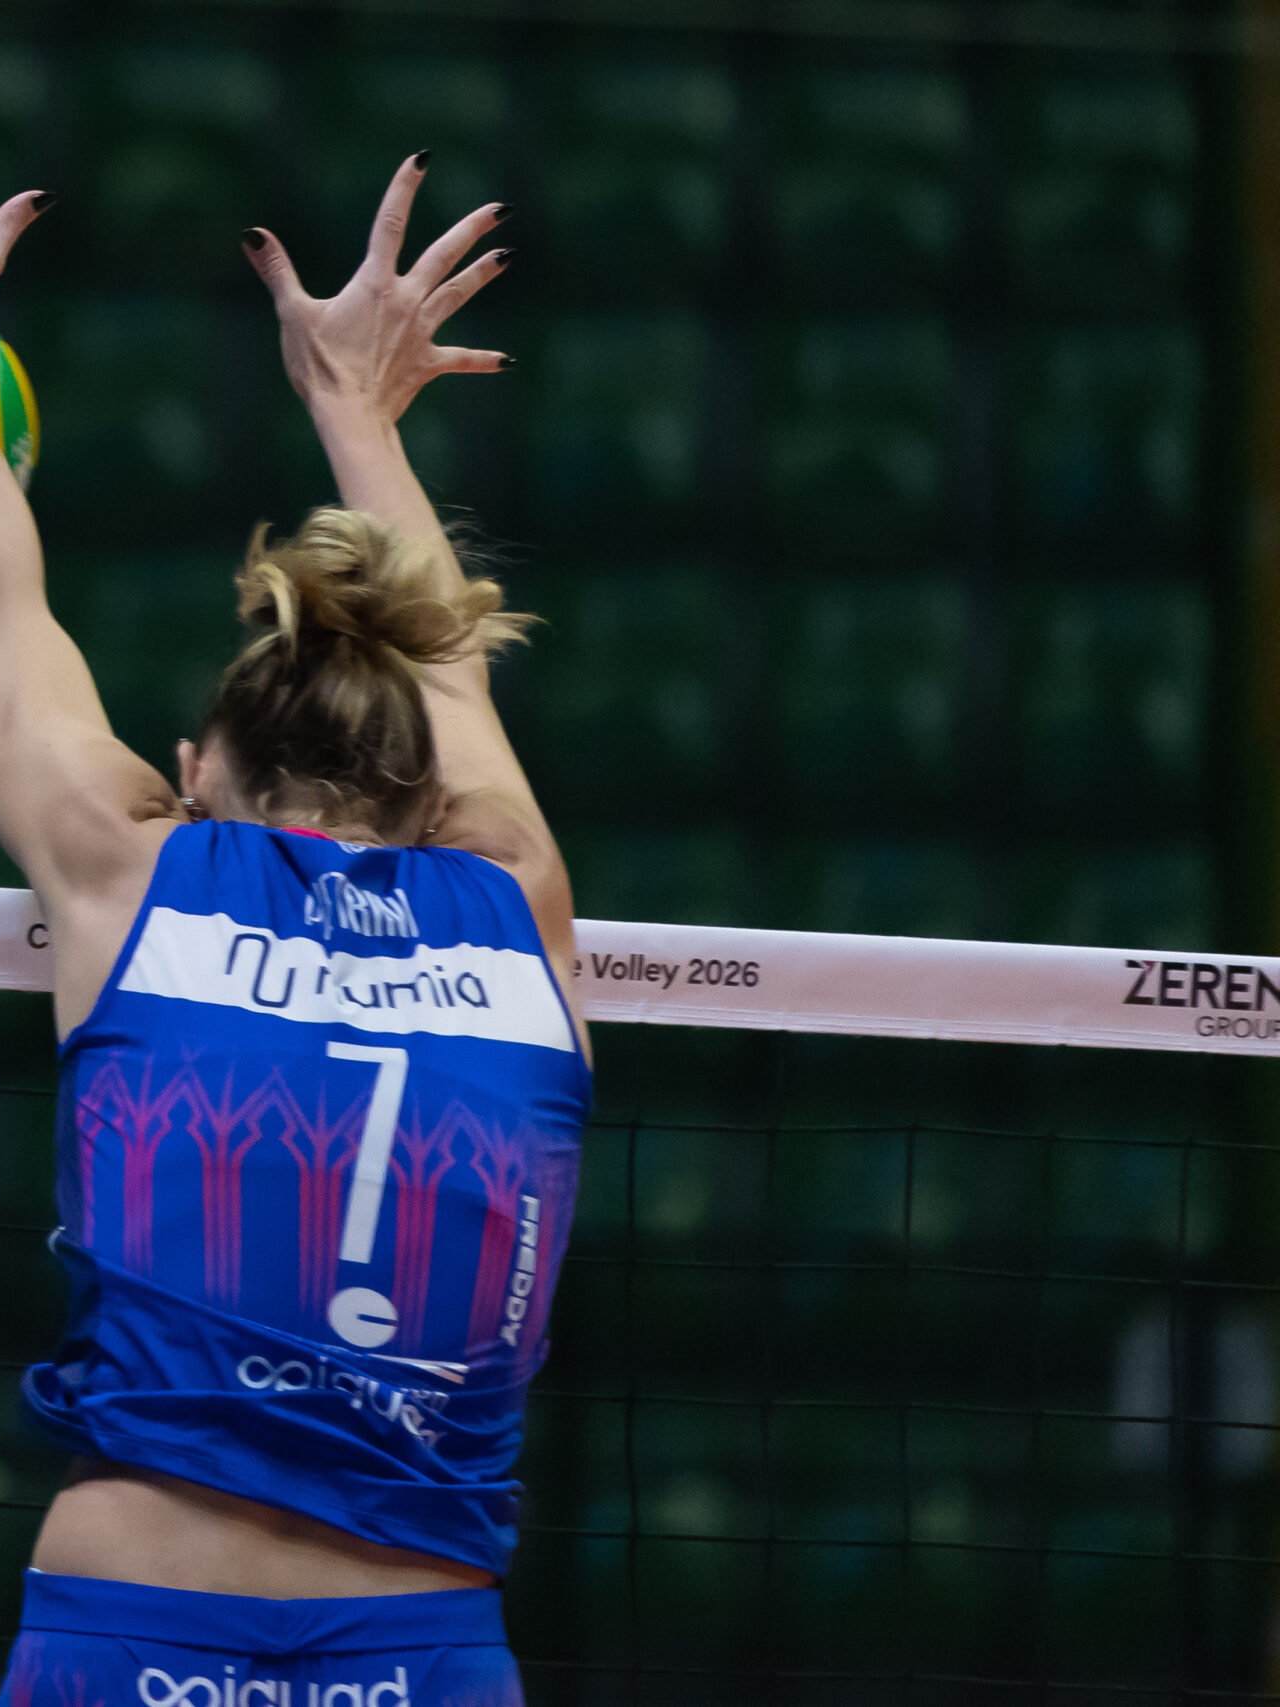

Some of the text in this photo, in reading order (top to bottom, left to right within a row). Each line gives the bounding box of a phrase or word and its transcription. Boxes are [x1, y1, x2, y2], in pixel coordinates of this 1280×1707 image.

[591, 953, 680, 989] Volley
[687, 958, 760, 987] 2026
[1123, 960, 1280, 1011] ZEREN
[326, 1040, 409, 1265] 7
[499, 1194, 541, 1347] FREDDY
